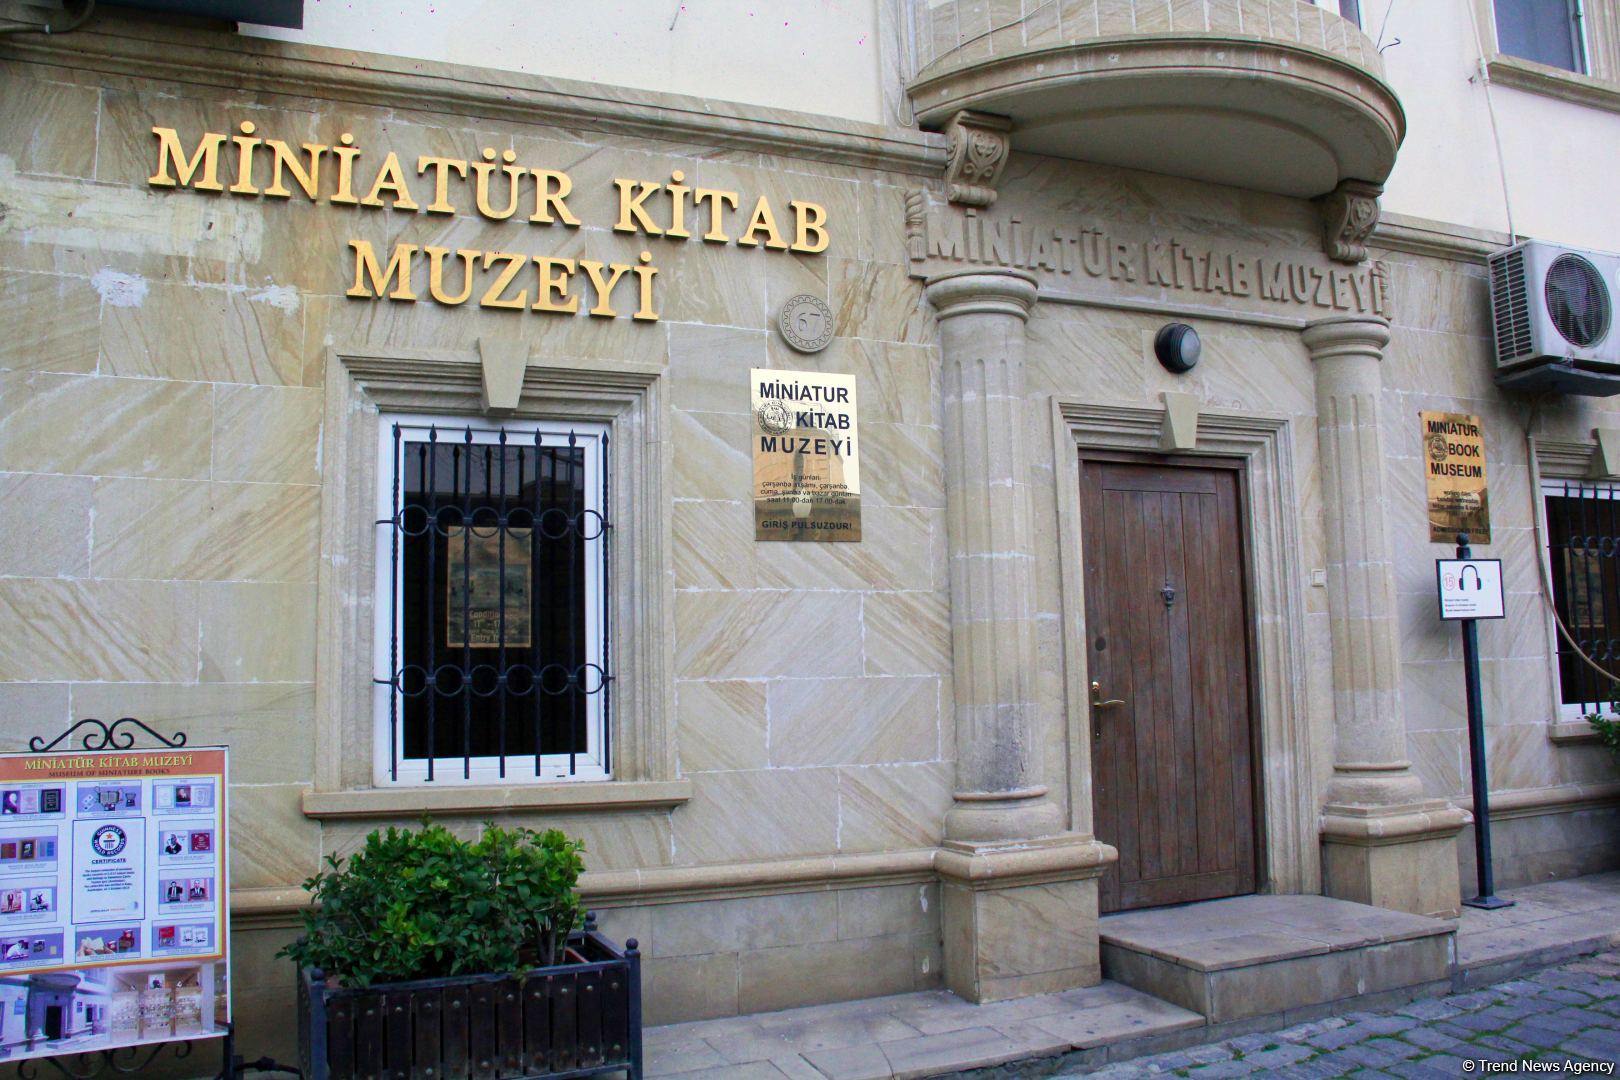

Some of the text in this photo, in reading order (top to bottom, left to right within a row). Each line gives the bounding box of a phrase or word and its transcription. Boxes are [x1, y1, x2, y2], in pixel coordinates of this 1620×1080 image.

[148, 121, 831, 254] MİNİATÜR KİTAB
[1144, 238, 1251, 297] KİTAB
[346, 239, 660, 322] MUZEYİ
[796, 312, 821, 336] 67
[760, 379, 849, 404] MİNİATUR
[796, 408, 851, 430] KİTAB
[761, 436, 851, 456] MUZEYİ
[1448, 443, 1480, 457] BOOK
[1430, 462, 1482, 478] MUSEUM
[25, 756, 95, 770] MİNİATÜR
[99, 755, 139, 768] KİTAB
